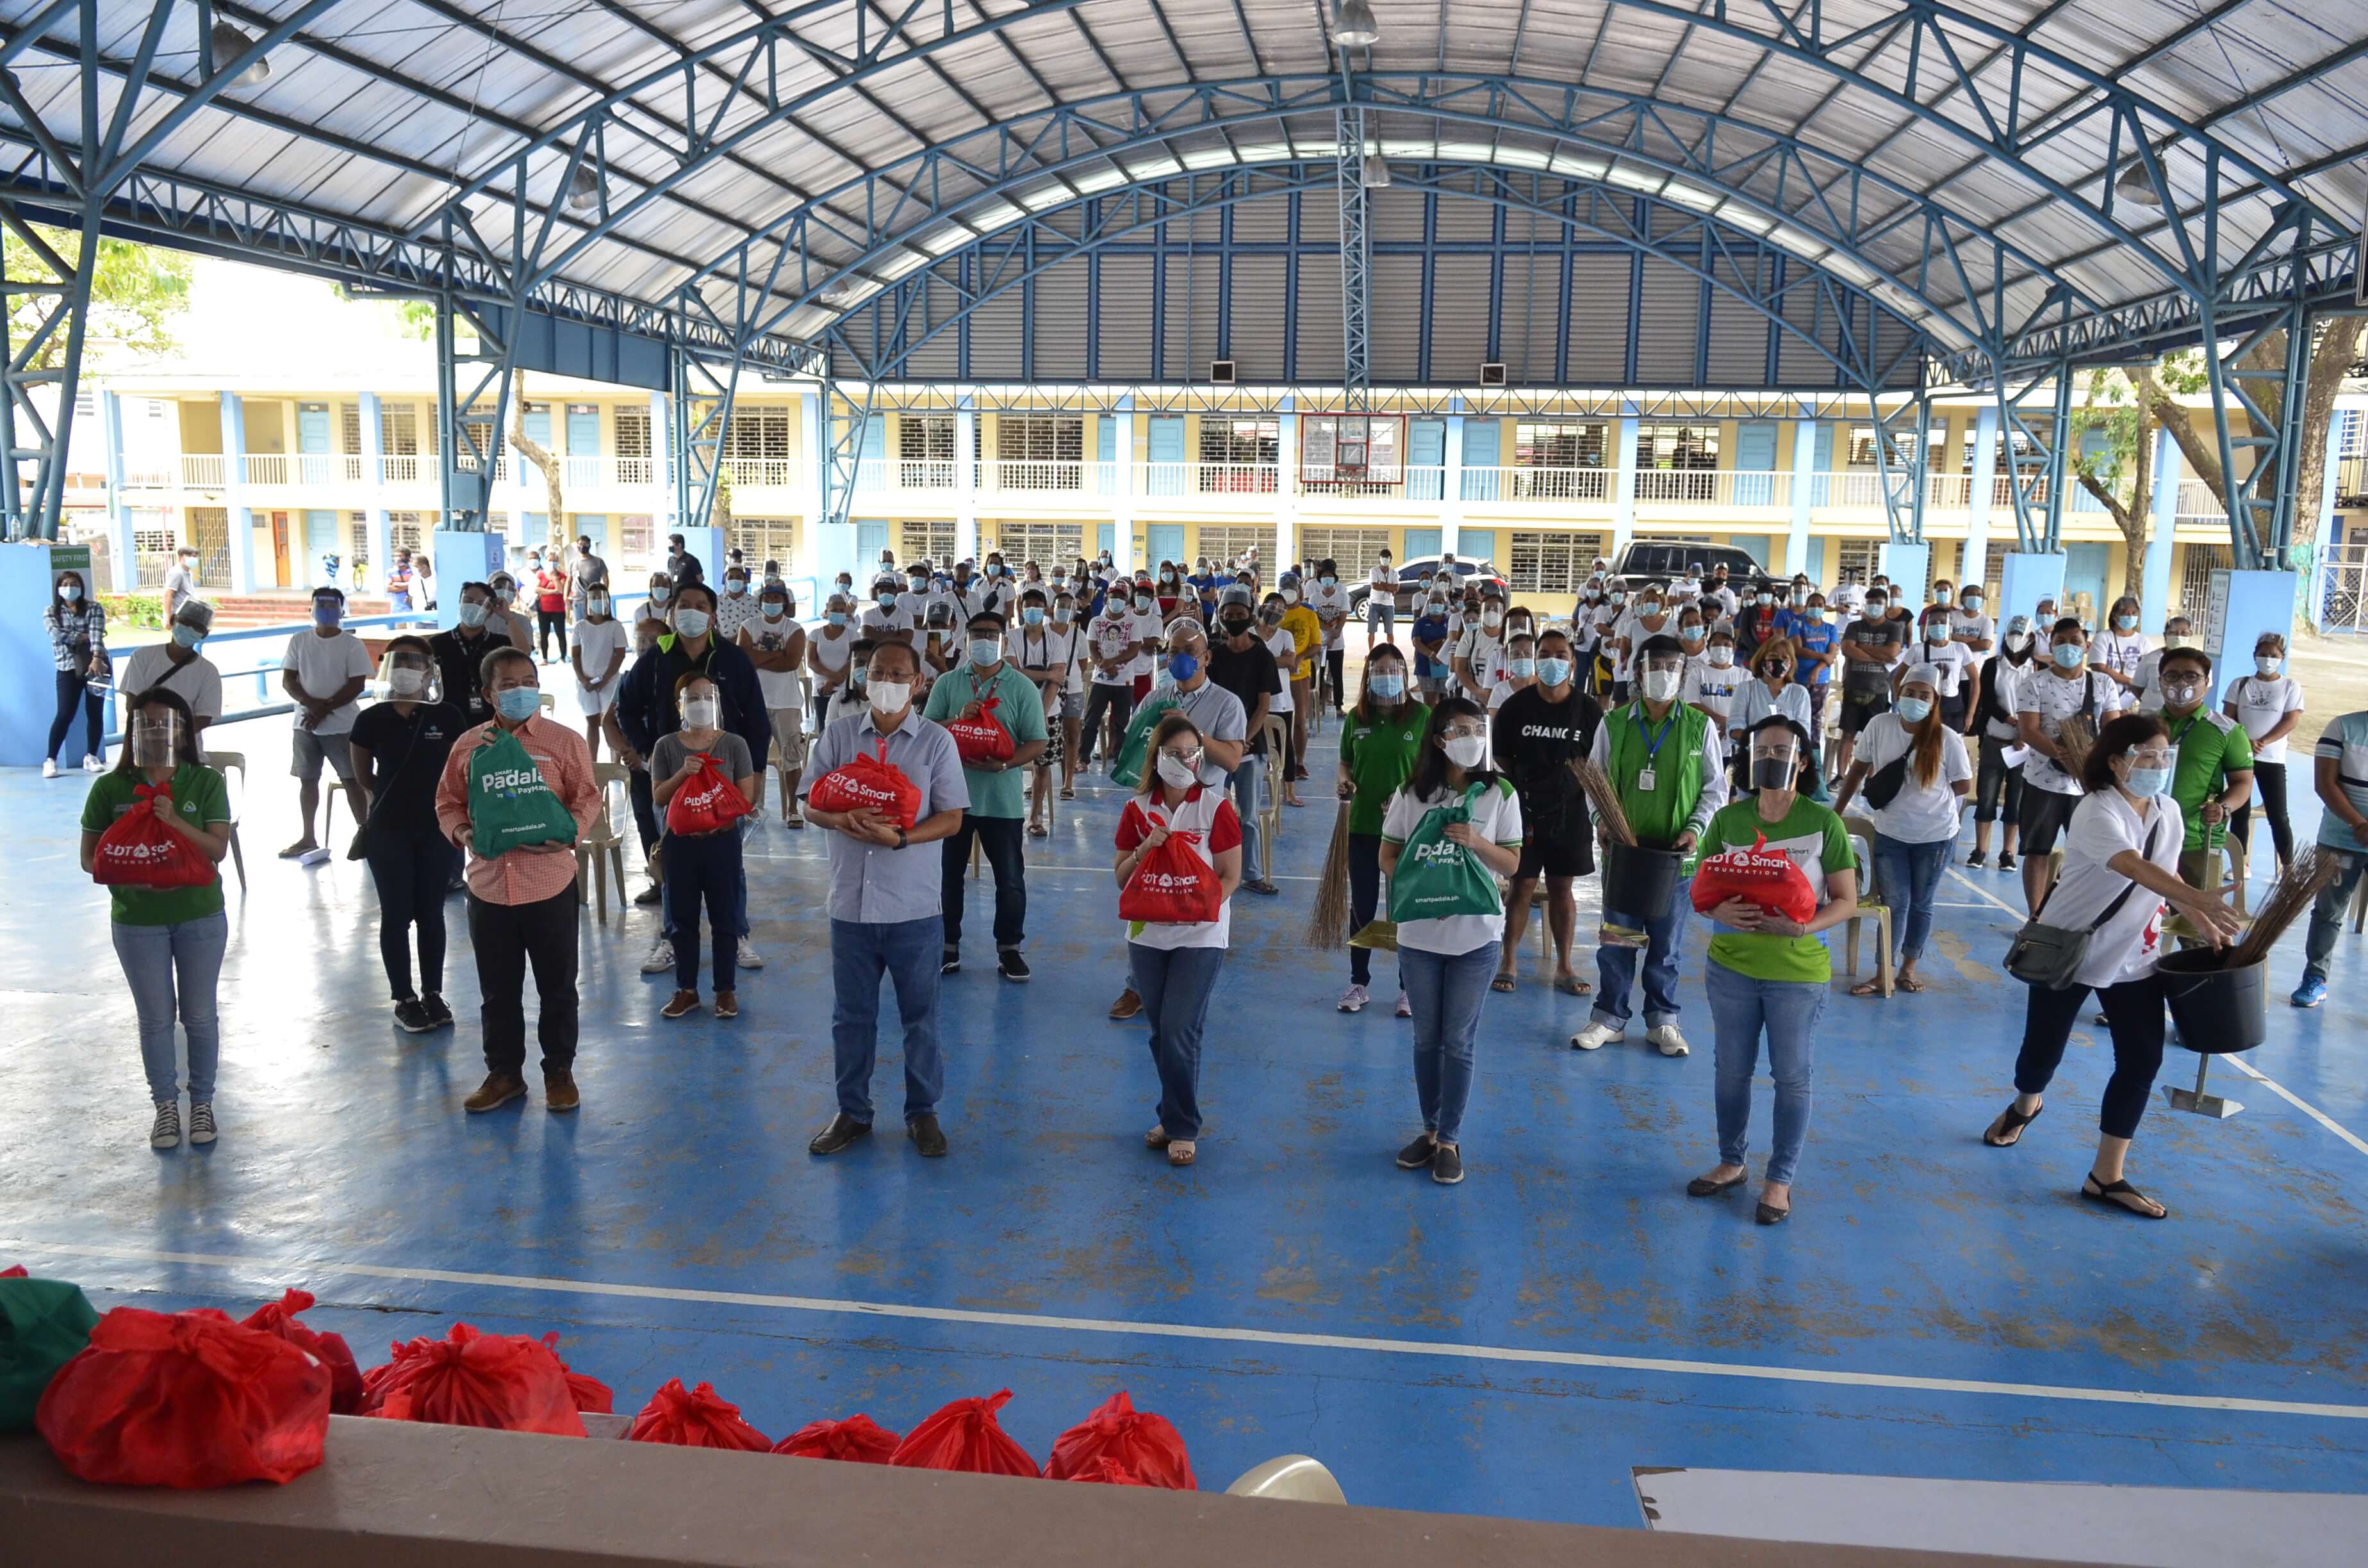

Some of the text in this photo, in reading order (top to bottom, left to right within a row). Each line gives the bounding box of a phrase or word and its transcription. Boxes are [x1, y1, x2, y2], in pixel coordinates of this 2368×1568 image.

[51, 555, 72, 563] SAFETY
[518, 785, 550, 794] PayMay
[826, 772, 896, 801] LDT Smart
[502, 822, 546, 833] smartpadala.ph
[1751, 854, 1791, 870] Smart
[1707, 867, 1779, 876] FOUNDATION
[1415, 895, 1459, 904] smartpadala.ph
